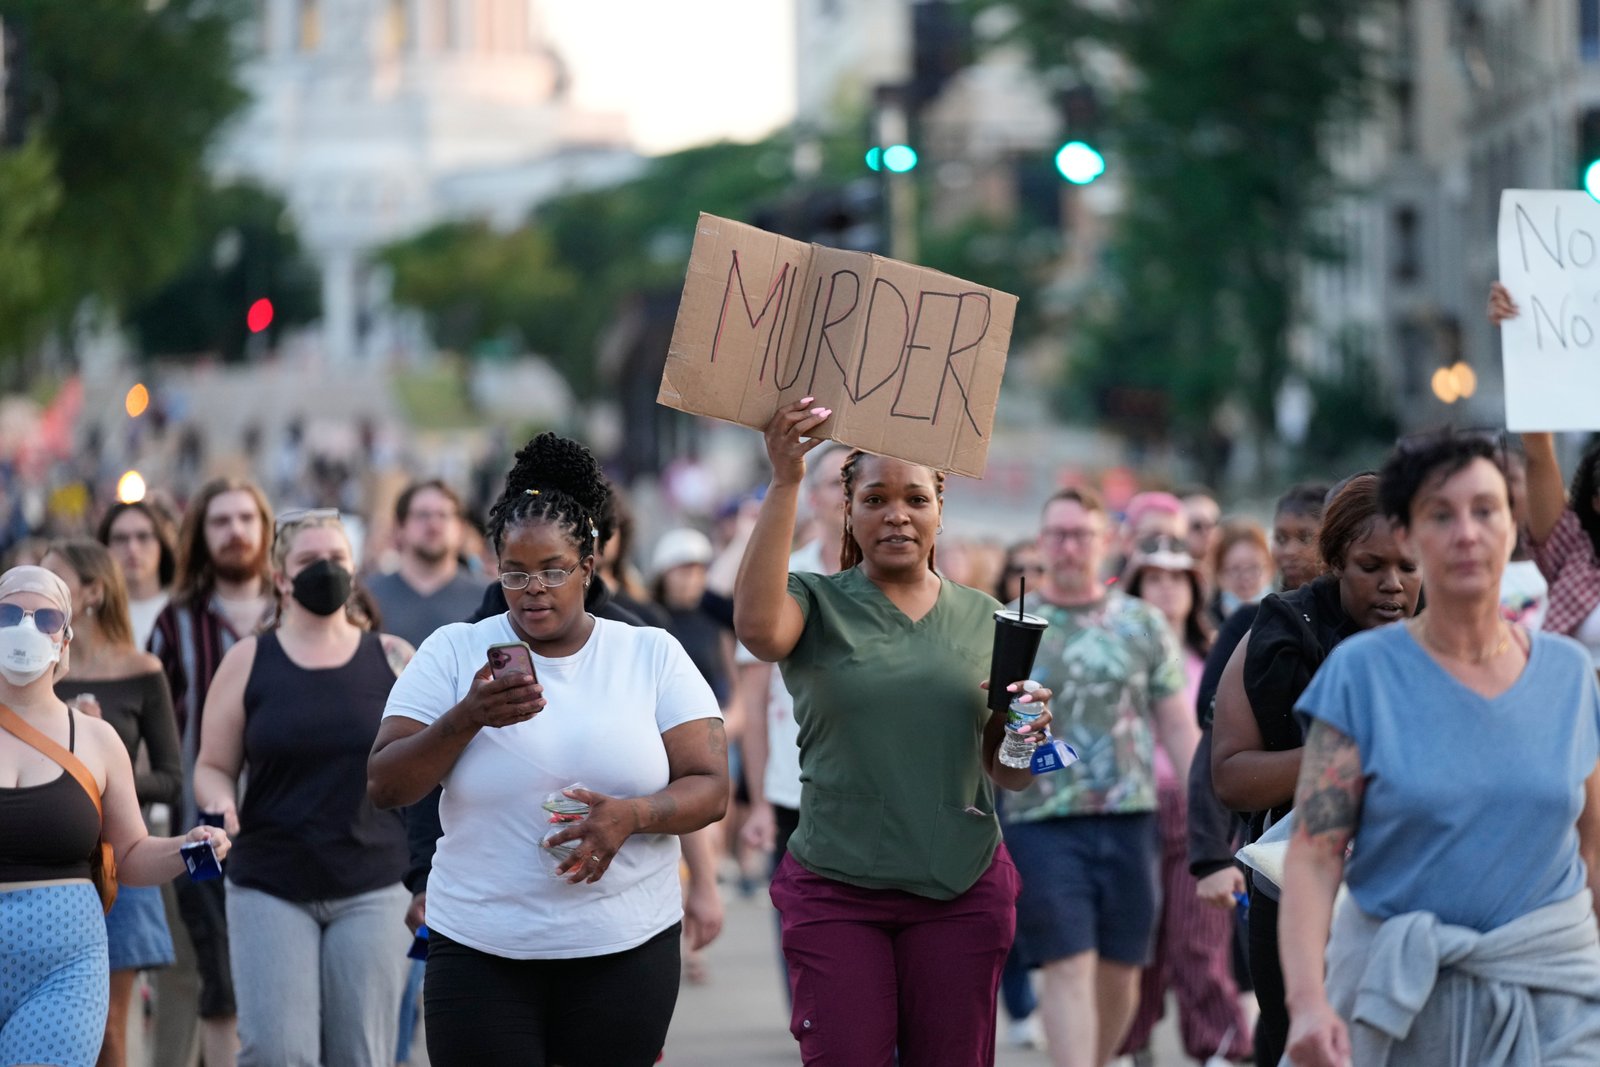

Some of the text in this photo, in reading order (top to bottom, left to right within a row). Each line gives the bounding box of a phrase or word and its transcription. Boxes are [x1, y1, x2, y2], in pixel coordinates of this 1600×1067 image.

[1514, 202, 1597, 273] No
[710, 249, 991, 437] MURDER
[1530, 294, 1595, 350] No
